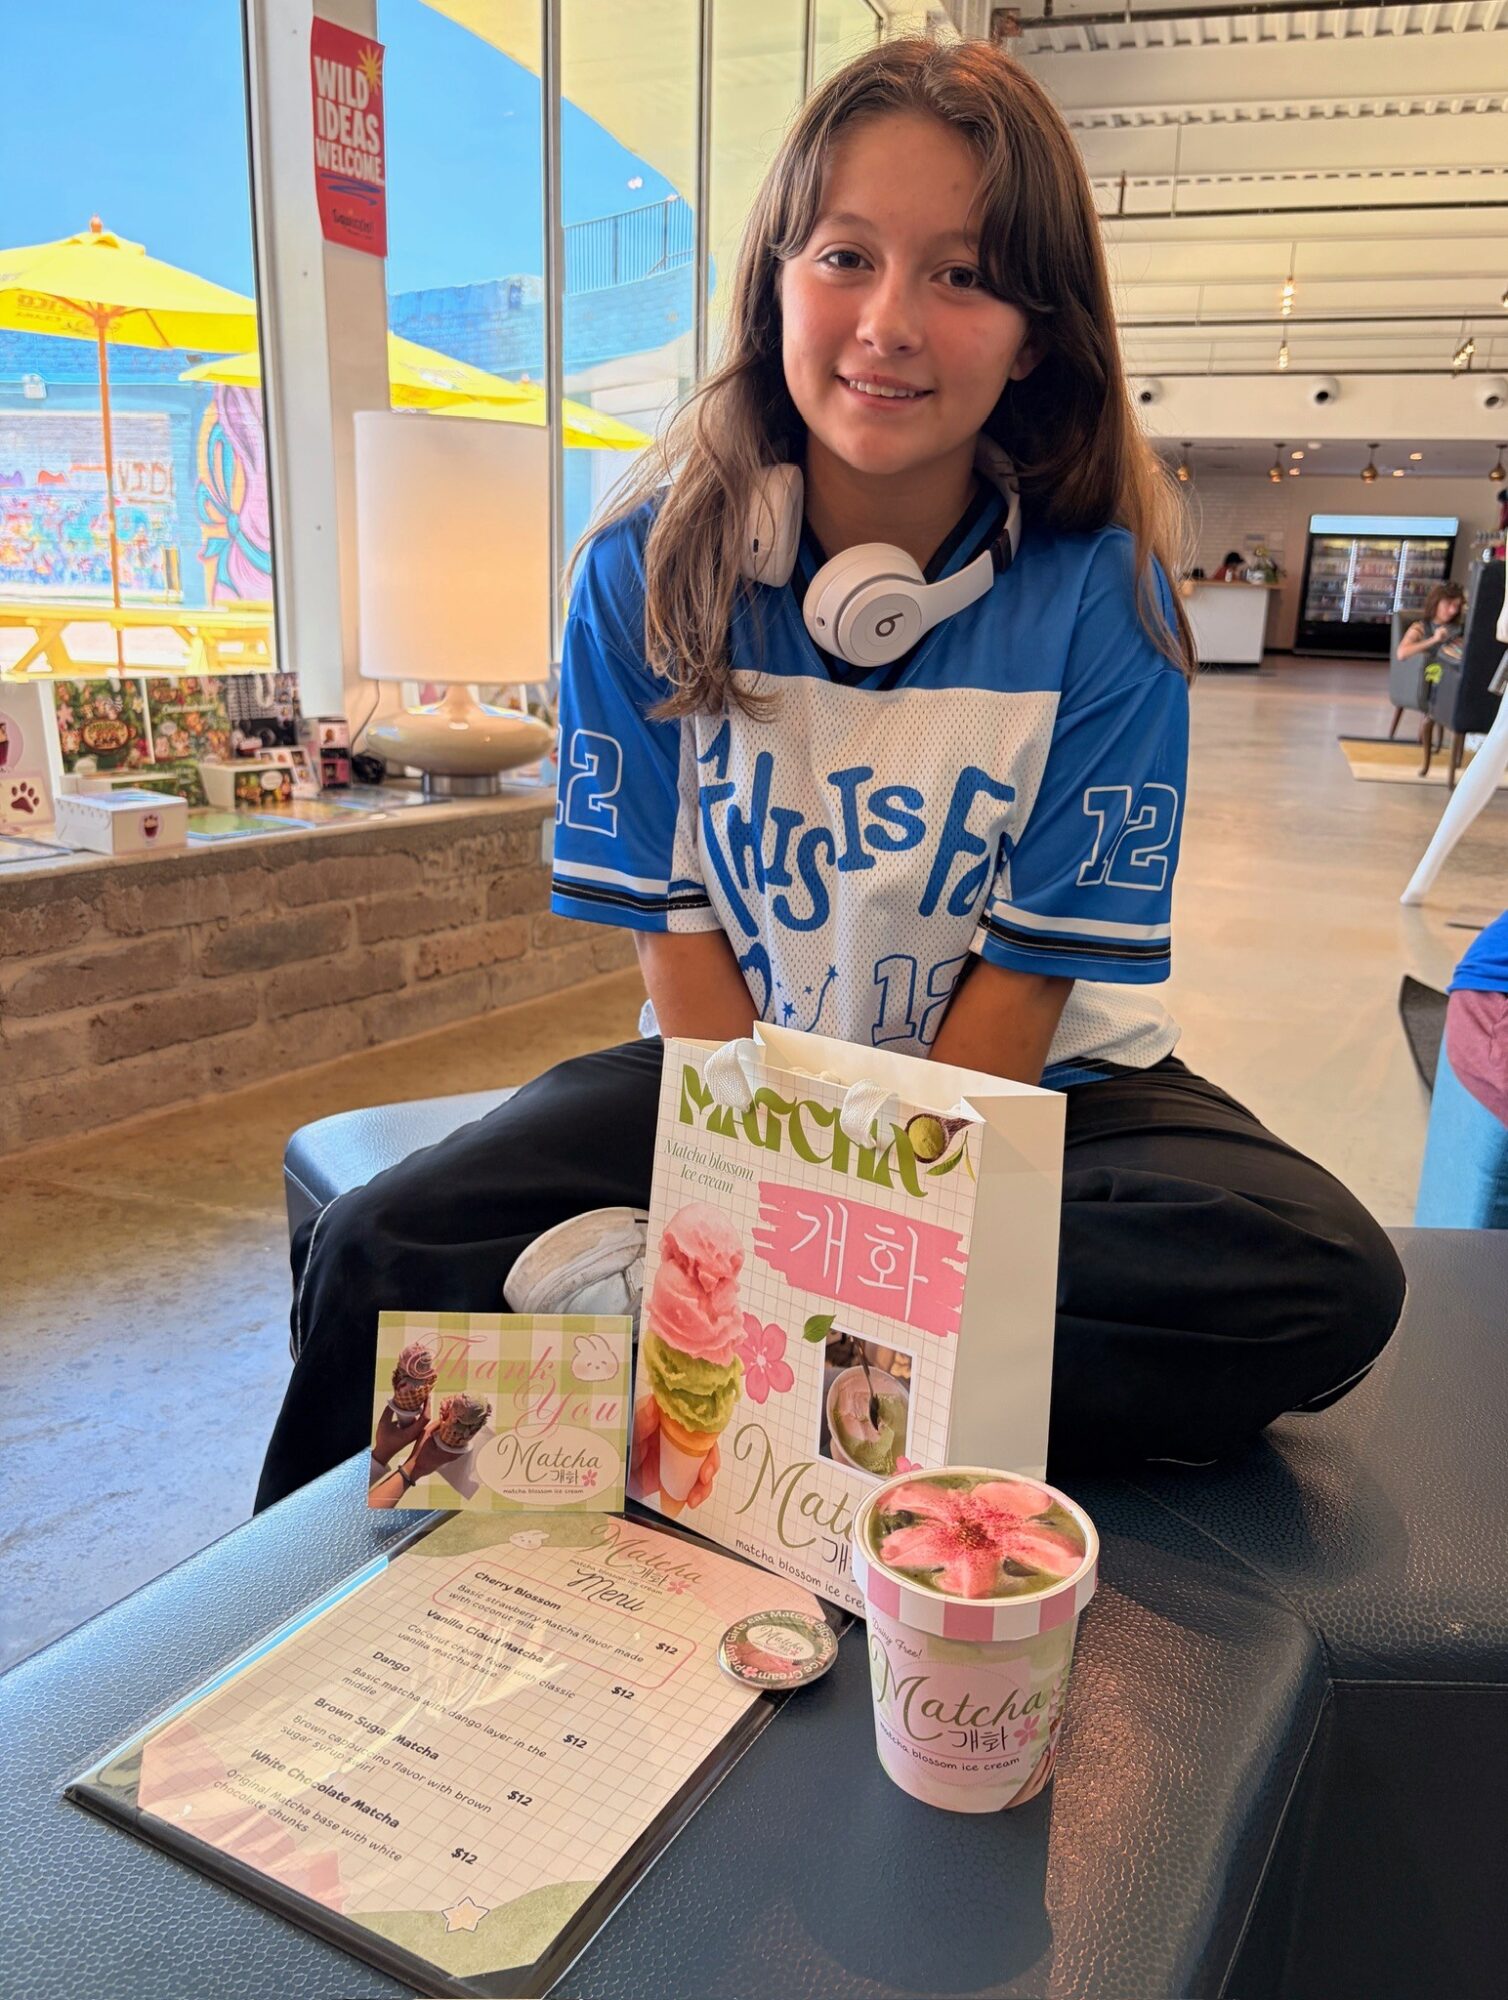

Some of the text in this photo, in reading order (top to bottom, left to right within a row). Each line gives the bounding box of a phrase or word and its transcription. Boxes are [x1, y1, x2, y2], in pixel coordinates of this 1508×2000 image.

[314, 56, 369, 110] WILD
[317, 97, 379, 155] IDEAS
[1076, 783, 1178, 891] 12
[679, 1064, 929, 1198] MATCHA
[664, 1140, 754, 1181] Matcha blossom
[680, 1163, 734, 1194] Ice cream
[790, 1201, 929, 1321] 개화
[405, 1332, 556, 1381] Thank
[513, 1374, 618, 1439] You
[497, 1434, 602, 1483] Matcha
[550, 1469, 579, 1485] 개화
[576, 1523, 703, 1584] Matcha
[632, 1564, 668, 1586] 개화
[735, 1538, 775, 1564] matcha
[779, 1559, 821, 1587] blossom
[825, 1580, 841, 1598] ice
[821, 1535, 856, 1582] 개
[475, 1571, 561, 1610] Cherry Blossom
[567, 1568, 647, 1612] Menu
[570, 1559, 596, 1571] matcha
[640, 1584, 663, 1596] cream
[449, 1592, 537, 1631] with coconut milk
[458, 1584, 645, 1663] Basic strawberry Matcha flavor made
[725, 1622, 748, 1643] Girls
[747, 1613, 769, 1625] eat
[770, 1611, 818, 1625] Matcha
[398, 1632, 498, 1678] vanilla matcha base
[427, 1609, 545, 1664] Vanilla Cloud Matcha
[655, 1641, 679, 1656] $12
[872, 1617, 923, 1660] Dairy Free!
[372, 1651, 411, 1674] Dango
[408, 1624, 450, 1645] Coconut
[451, 1643, 483, 1661] cream
[538, 1678, 576, 1700] classic
[758, 1671, 804, 1680] Cream
[341, 1676, 377, 1697] middle
[611, 1686, 635, 1701] $12
[869, 1634, 1047, 1741] Matcha
[314, 1697, 439, 1761] Brown Sugar Matcha
[352, 1667, 548, 1758] Basic matcha with dango layer in the
[280, 1726, 312, 1746] sugar
[312, 1740, 345, 1761] syrup
[563, 1733, 588, 1749] $12
[879, 1721, 1020, 1771] matcha blossom ice cream
[948, 1725, 1009, 1752] 개화
[292, 1714, 493, 1814] Brown cappuccino flavor with brown
[213, 1780, 310, 1832] chocolate chunks
[250, 1749, 400, 1829] White Chocolate Matcha
[507, 1790, 533, 1807] $12
[226, 1768, 403, 1862] Original Matcha base with white
[451, 1847, 478, 1866] $12
